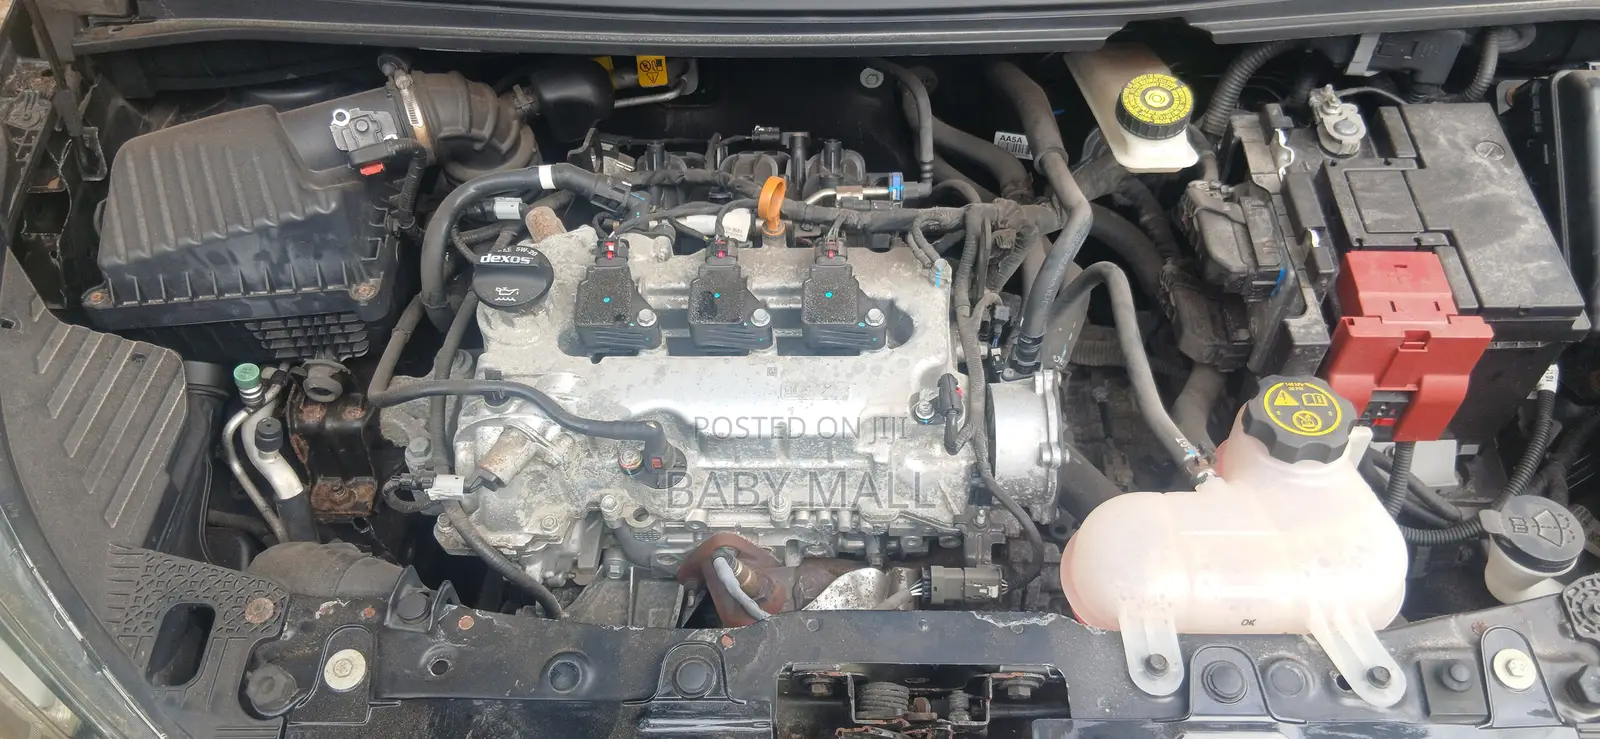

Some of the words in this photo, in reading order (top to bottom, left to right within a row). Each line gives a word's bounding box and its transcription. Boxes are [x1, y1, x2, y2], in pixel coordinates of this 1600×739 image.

[515, 246, 539, 257] 5W-20
[480, 253, 532, 264] dexos
[1241, 618, 1257, 627] OK
